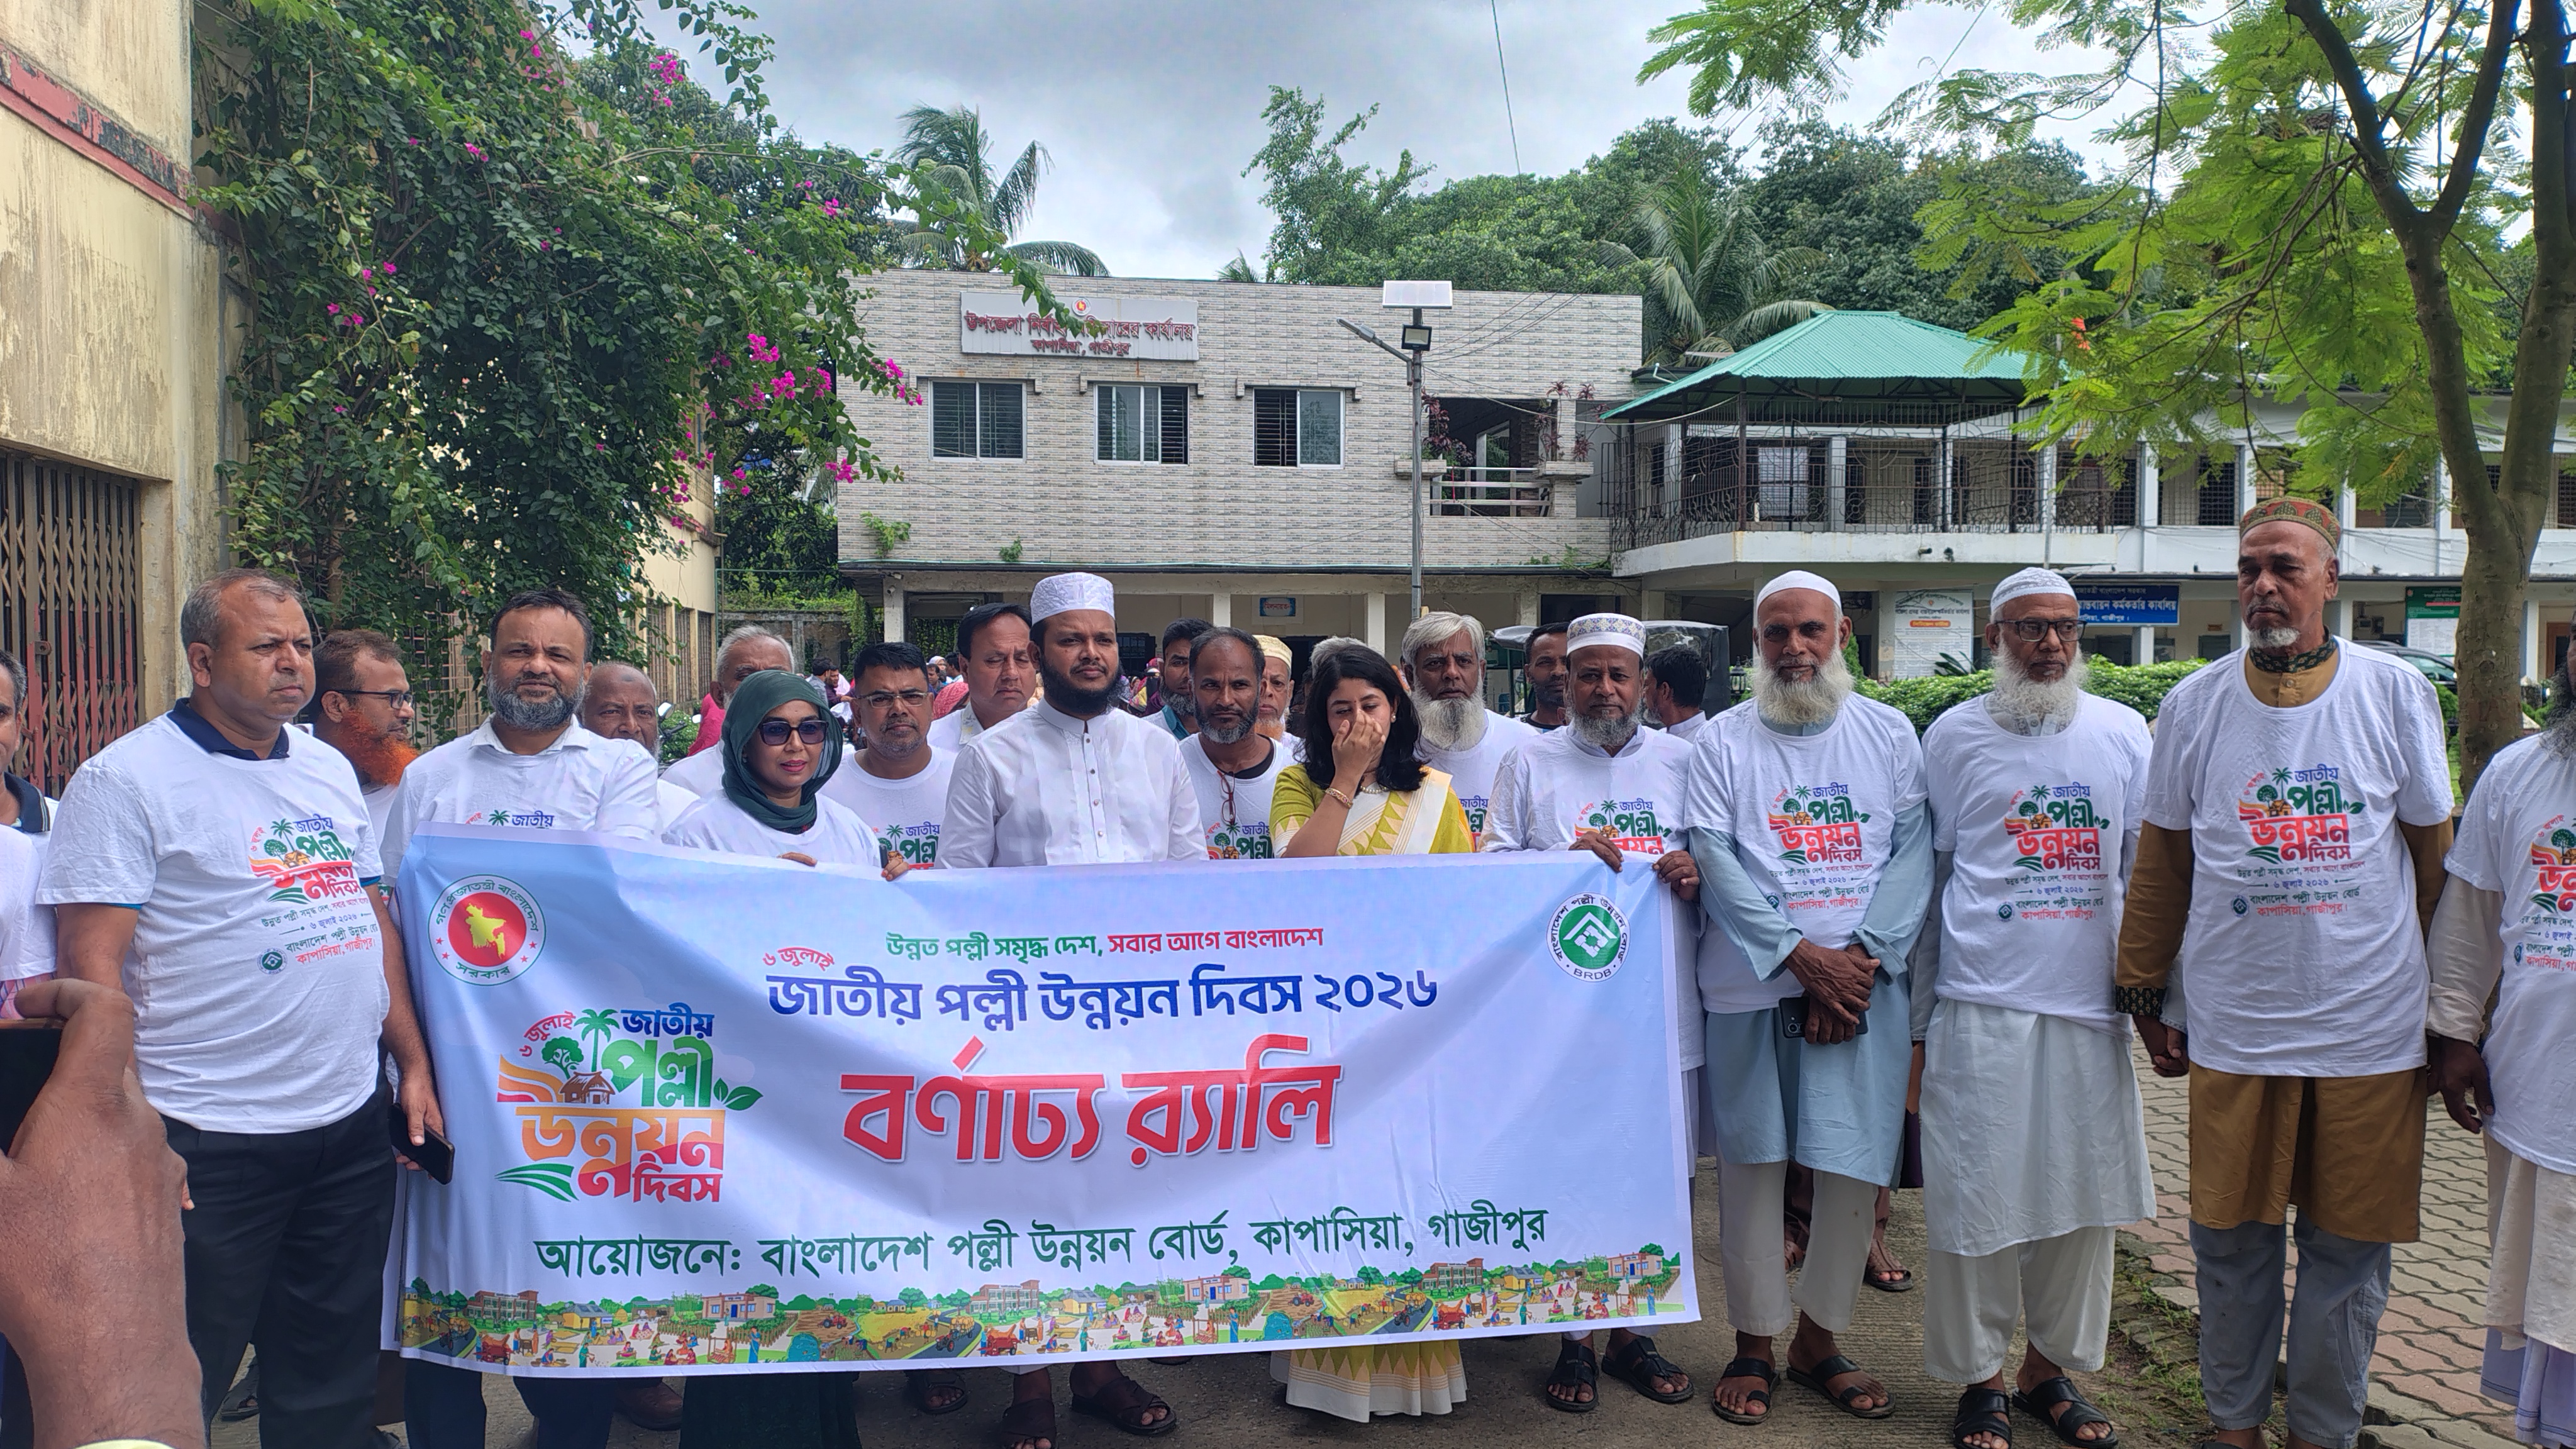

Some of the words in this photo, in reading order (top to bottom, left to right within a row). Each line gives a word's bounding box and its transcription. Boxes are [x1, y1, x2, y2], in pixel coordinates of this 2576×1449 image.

[964, 311, 1023, 335] উপজেলা
[1026, 313, 1067, 337] নির্বাহ
[1143, 317, 1196, 340] কার্যালয়
[1089, 339, 1131, 356] গাজীপুর
[2294, 763, 2339, 782] জাতীয়
[1813, 782, 1848, 797] জাতীয়
[2052, 782, 2090, 798] জাতীয়
[2287, 781, 2343, 816] পল্লী
[1619, 797, 1653, 811] জাতীয়
[1807, 796, 1855, 824] পল্লী
[2046, 797, 2095, 828] পল্লী
[292, 814, 334, 833] জাতীয়
[512, 810, 555, 827] জাতীয়
[905, 821, 941, 836] জাতীয়
[1614, 810, 1658, 837] পল্লী
[296, 831, 350, 861] পল্লী
[1778, 821, 1862, 862] উন্নয়ন
[2016, 828, 2101, 870] উন্নয়ন
[2248, 814, 2350, 862] উন্নয়ন
[1827, 847, 1862, 863] দিবস
[2065, 853, 2101, 870] দিবস
[2307, 841, 2351, 862] দিবস
[326, 879, 362, 898] দিবস
[1782, 890, 1815, 900] বাংলাদেশ
[2250, 893, 2289, 904] বাংলাদেশ
[2343, 885, 2361, 899] বোর্ড
[498, 884, 539, 932] বাংলাদেশ
[285, 934, 328, 953] বাংলাদেশ
[331, 927, 347, 941] পল্লী
[886, 931, 939, 961] উন্নত
[946, 931, 989, 961] পল্লী
[994, 937, 1050, 964] সমৃদ্ধ
[1055, 935, 1102, 957] দেশ,
[1108, 932, 1163, 954] সবার
[1166, 931, 1220, 952] আগে
[1224, 928, 1324, 949] বাংলাদেশ
[296, 944, 345, 964] কাপাসিয়া,
[762, 952, 776, 966] ৬
[776, 947, 835, 972] জুলাই
[456, 962, 511, 979] সরকার
[1574, 968, 1612, 980] BRDB
[765, 965, 923, 1025] জাতীয়
[936, 969, 1029, 1031] পল্লী
[1037, 971, 1180, 1030] উন্নয়ন
[1188, 963, 1303, 1016] দিবস
[1314, 969, 1438, 1013] ২০২৬
[523, 1010, 576, 1041] জুলাই
[621, 1002, 714, 1039] জাতীয়
[519, 1045, 533, 1057] ৬
[601, 1036, 714, 1107] পল্লী
[839, 1035, 1108, 1163] বর্ণাঢ্য
[514, 1106, 726, 1198] উন্নয়ন
[632, 1161, 723, 1203] দিবস
[757, 1231, 934, 1278] বাংলাদেশ
[947, 1219, 1018, 1273] পল্লী
[1027, 1219, 1137, 1272] উন্নয়ন
[1148, 1209, 1238, 1265] বোর্ড,
[1248, 1206, 1414, 1257] কাপাসিয়া,
[1427, 1199, 1549, 1253] গাজীপুর
